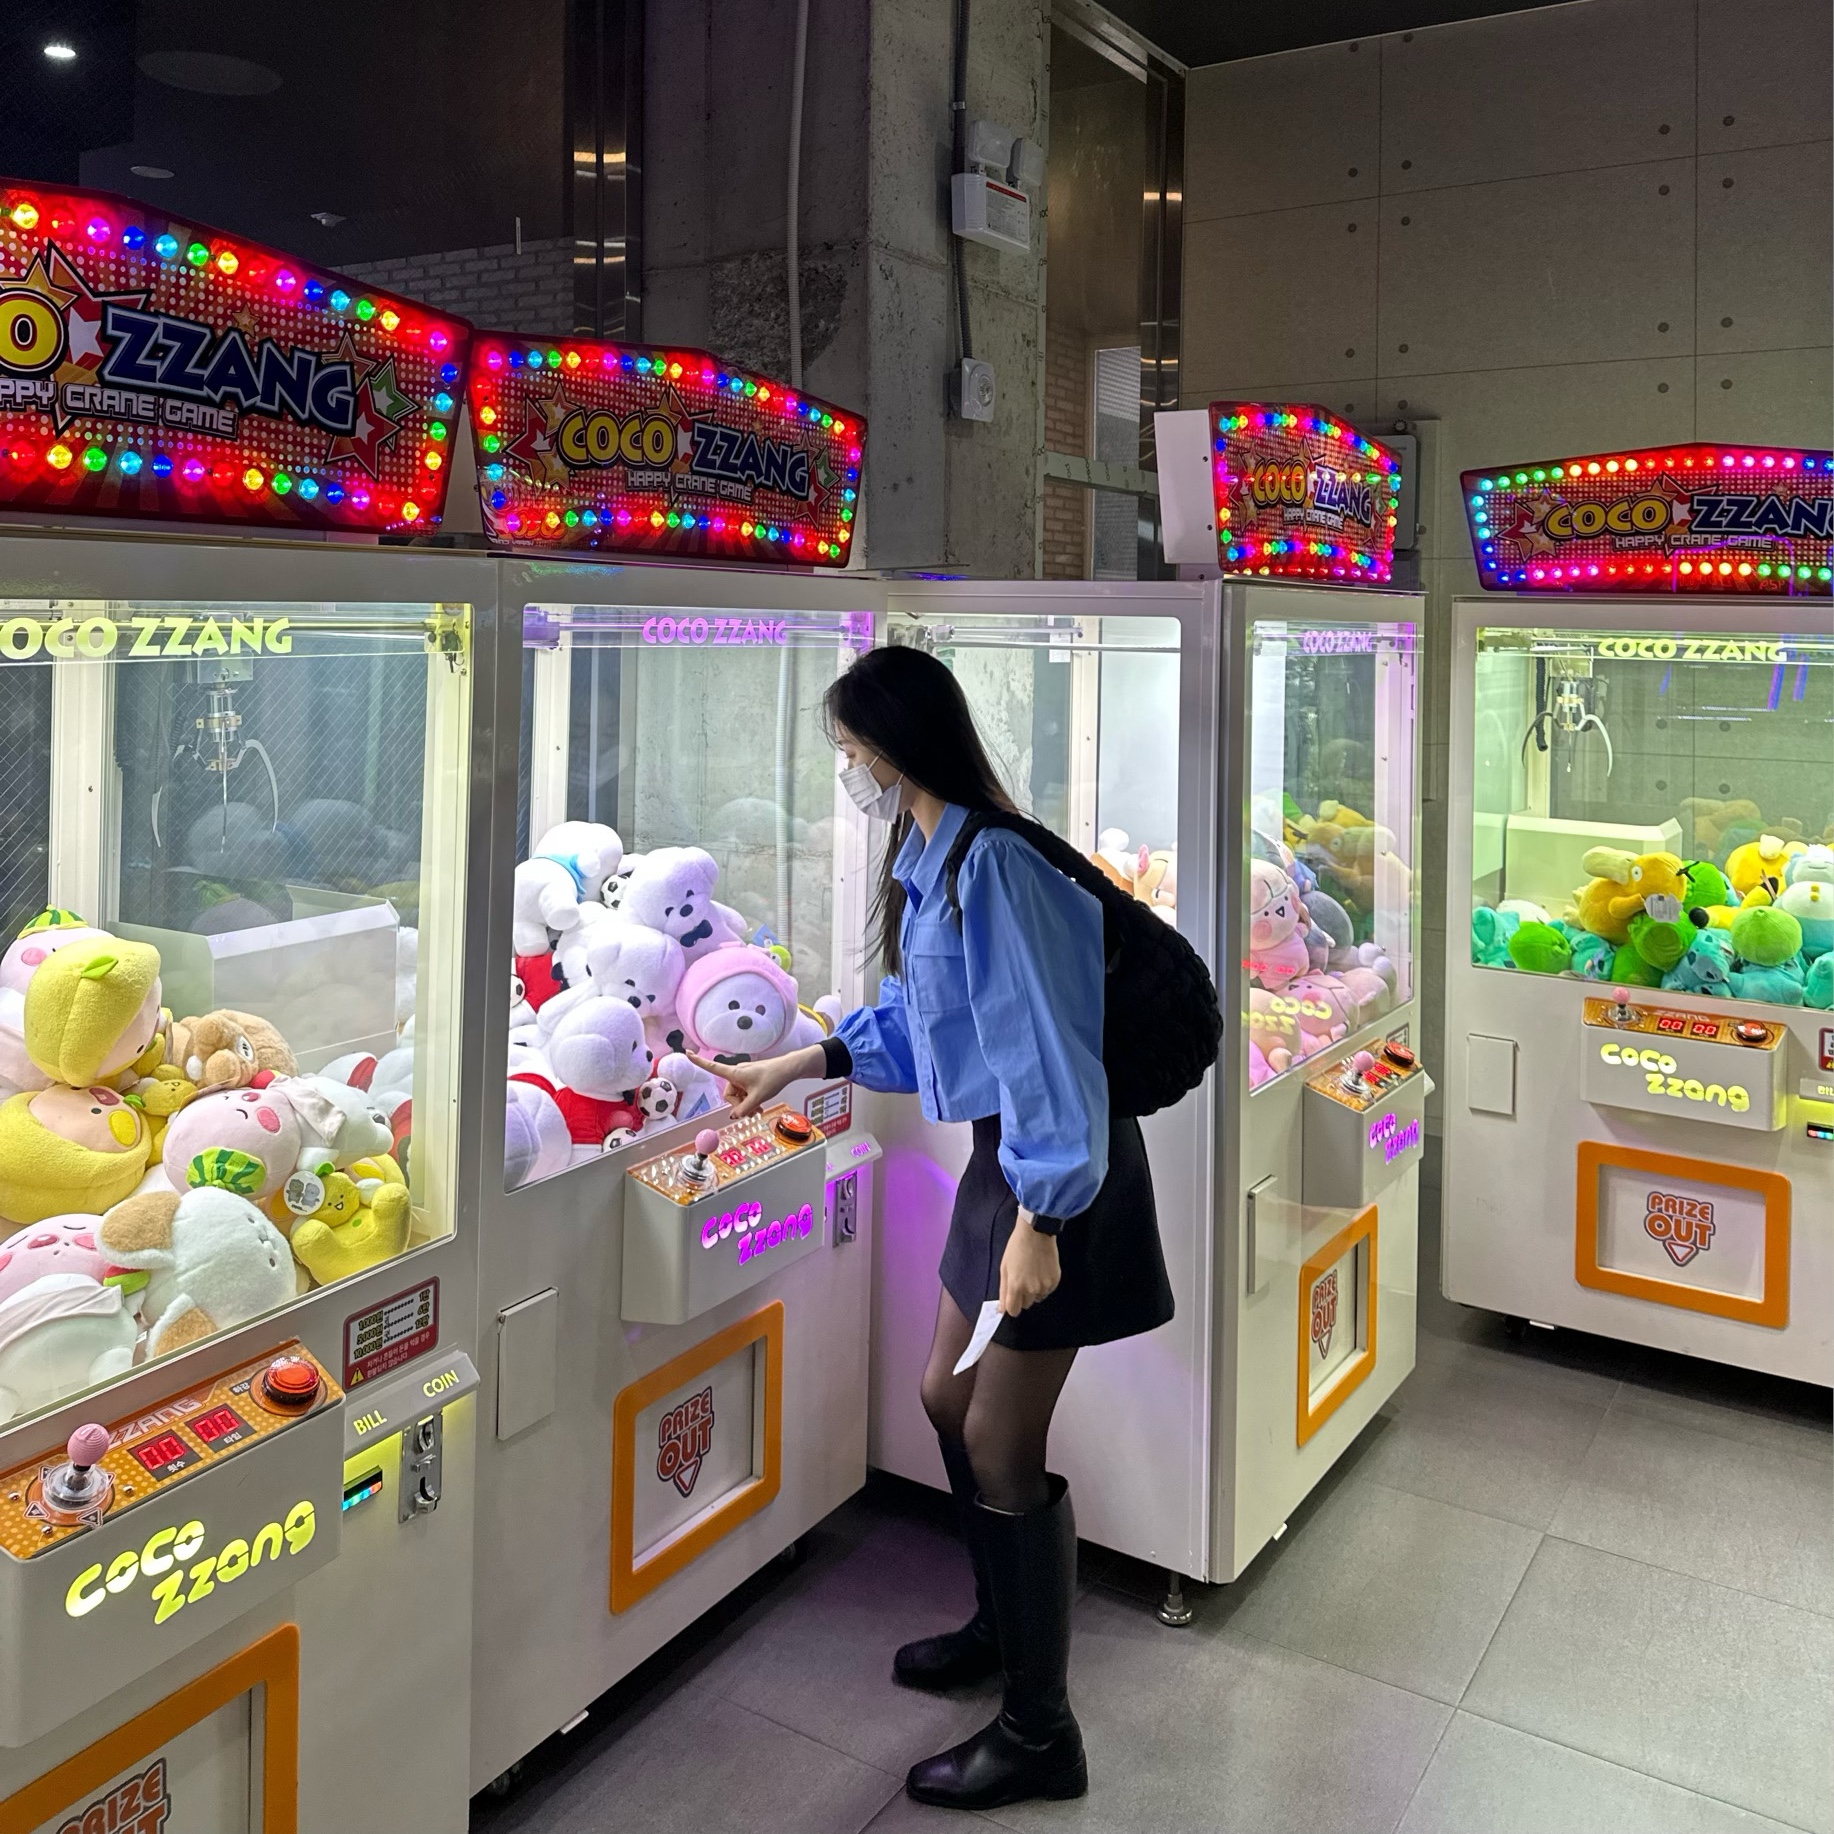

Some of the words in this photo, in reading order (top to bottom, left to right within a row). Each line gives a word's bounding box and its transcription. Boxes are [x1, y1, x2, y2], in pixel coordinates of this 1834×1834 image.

[103, 306, 358, 438] ZZANG
[66, 384, 157, 419] CRANE
[165, 400, 236, 432] GAME
[558, 411, 676, 465] COCO
[692, 423, 809, 496] ZZANG
[628, 470, 671, 487] HAPPY
[675, 474, 717, 494] CRANE
[719, 480, 754, 501] GAME
[1253, 460, 1307, 504] COCO
[1314, 465, 1373, 523] ZZANG
[1284, 507, 1305, 521] HAPPY
[1545, 500, 1670, 539] COCO
[1615, 535, 1665, 549] HAPPY
[1670, 534, 1725, 547] CRANE
[1727, 536, 1774, 550] GAME
[128, 616, 293, 657] ZZANG
[641, 617, 709, 644] COCO
[713, 618, 787, 645] ZZANG
[1303, 631, 1334, 653] COCO
[1336, 631, 1372, 653] ZZANG
[1598, 638, 1677, 659] COCO
[1682, 638, 1787, 662] ZZANG
[850, 1141, 871, 1158] COIN
[1649, 1193, 1712, 1222] PRIZE
[1646, 1212, 1715, 1250] OUT
[1313, 1270, 1338, 1309] PRIZE
[1311, 1295, 1338, 1342] OUT
[232, 1382, 250, 1394] 하강
[422, 1369, 460, 1398] COIN
[353, 1409, 388, 1436] BILL
[660, 1388, 712, 1446] PRIZE
[138, 1435, 187, 1470] 00
[193, 1409, 240, 1443] 00
[167, 1461, 186, 1473] 횟수
[223, 1432, 242, 1444] 타임
[658, 1413, 713, 1478] OUT
[60, 1762, 164, 1834] RIZE
